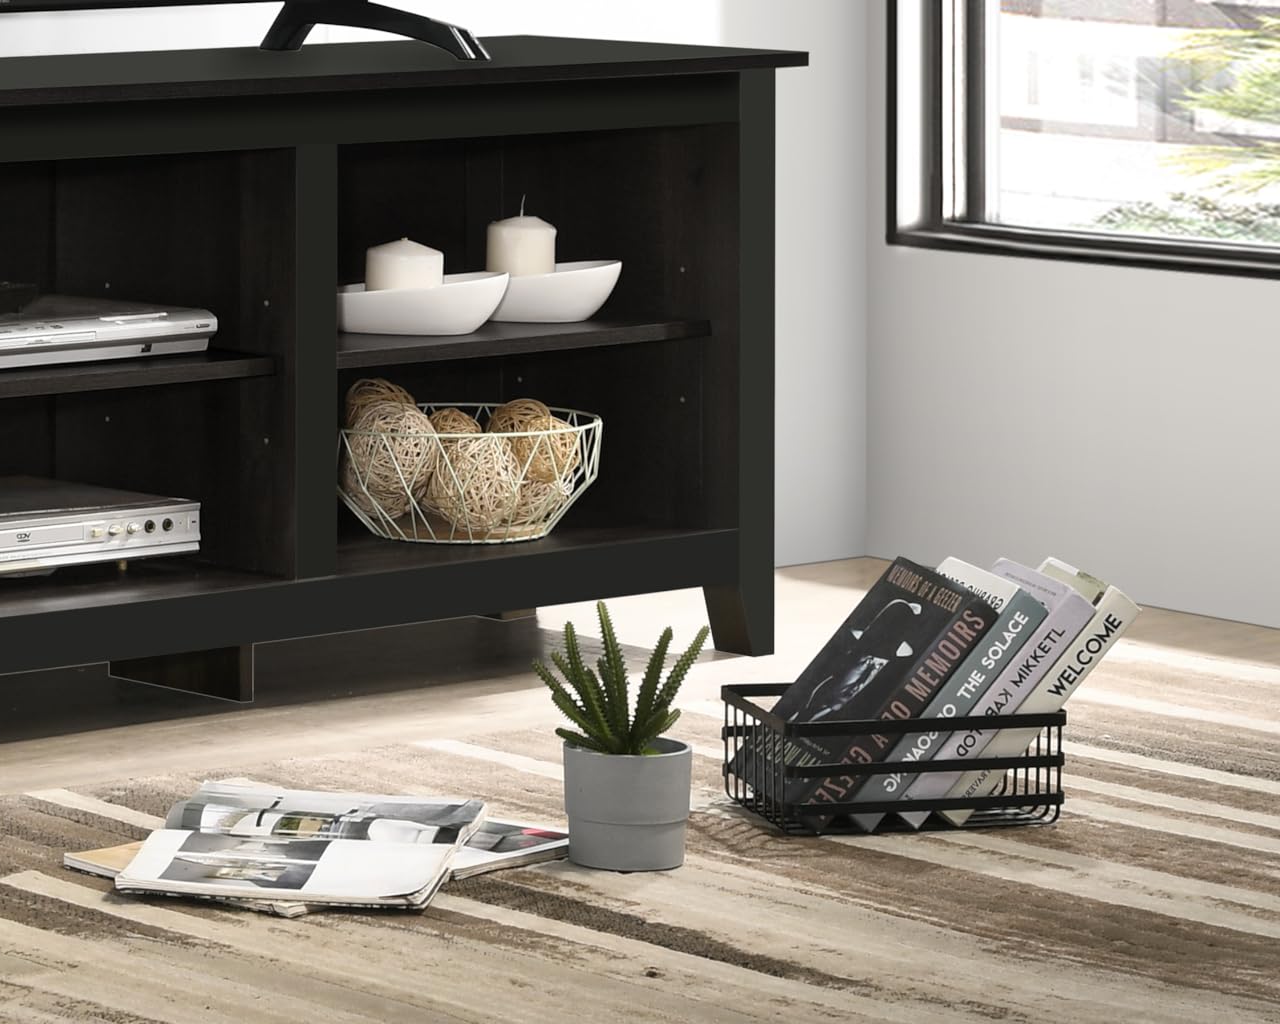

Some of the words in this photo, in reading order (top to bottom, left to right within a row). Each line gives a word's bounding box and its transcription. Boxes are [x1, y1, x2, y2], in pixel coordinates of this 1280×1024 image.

[904, 609, 985, 703] MEMOIRS
[956, 670, 986, 699] THE
[981, 611, 1030, 669] SOLACE
[1010, 628, 1066, 688] MIKKETL
[1047, 613, 1123, 697] WELCOME
